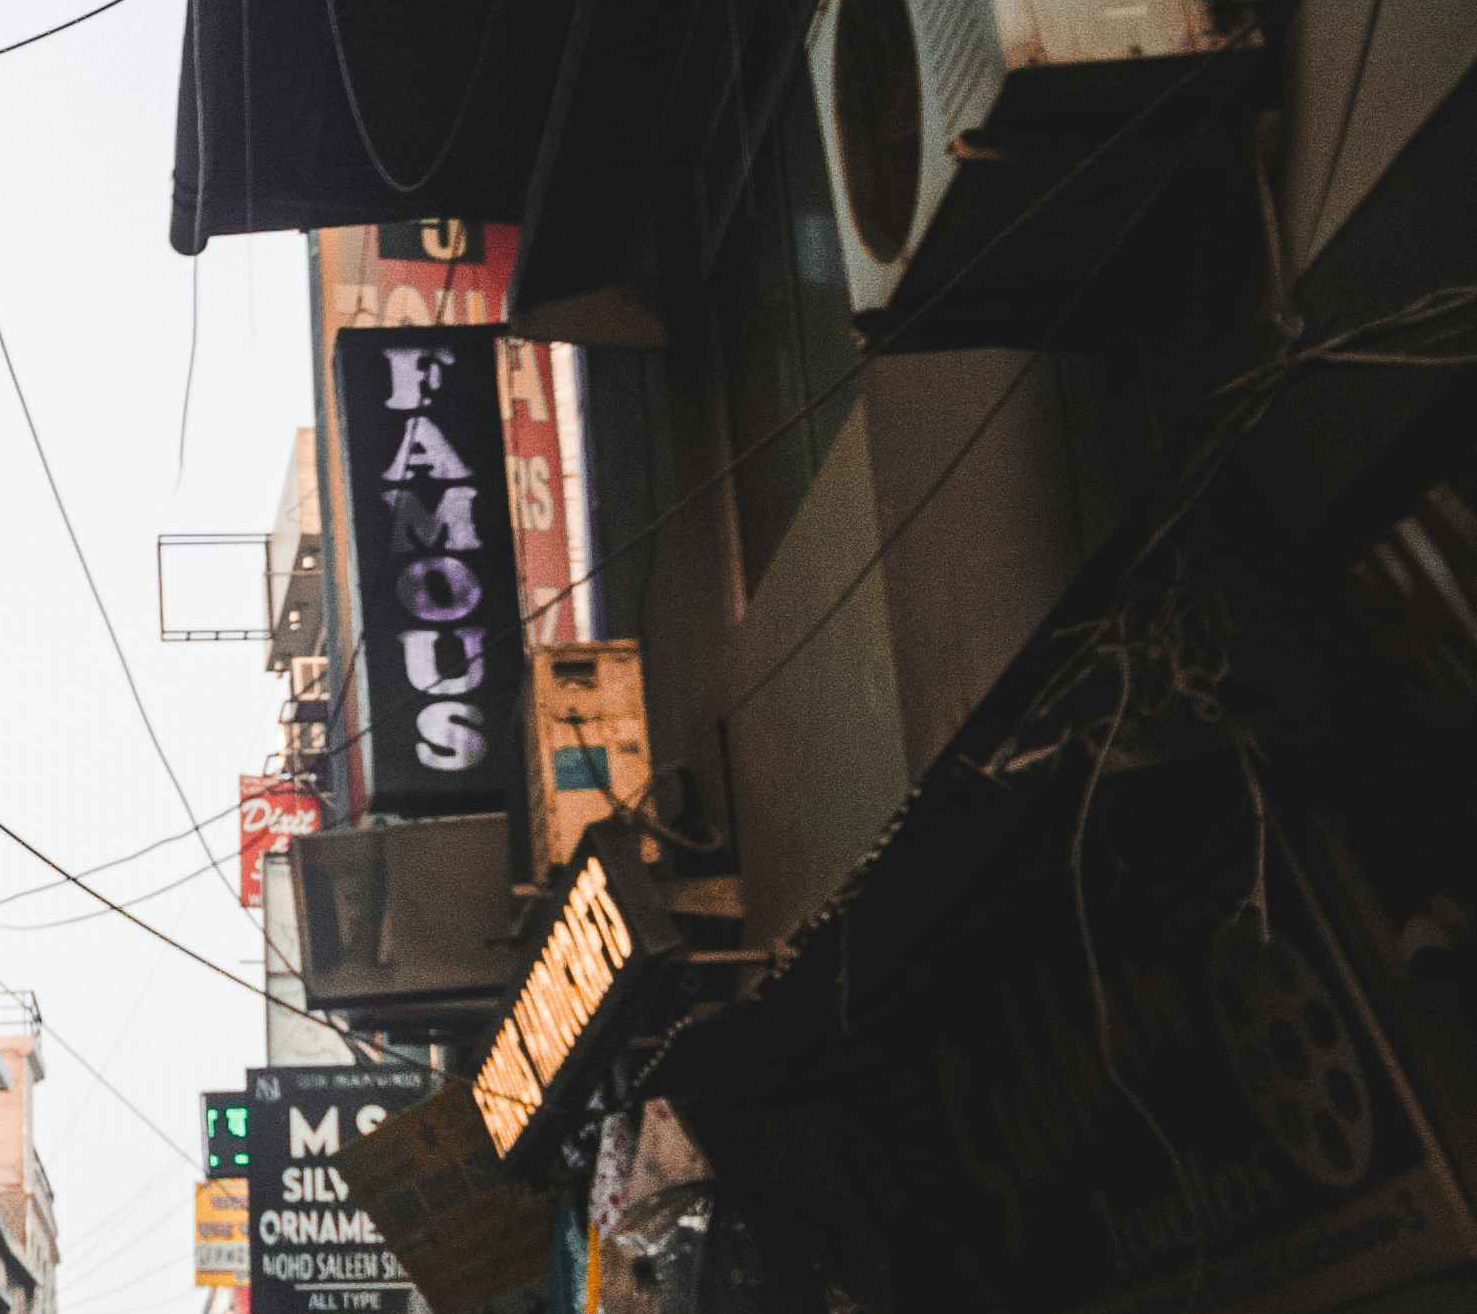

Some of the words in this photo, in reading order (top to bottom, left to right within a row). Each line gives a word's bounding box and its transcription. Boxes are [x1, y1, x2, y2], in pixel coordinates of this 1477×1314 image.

[381, 346, 488, 771] FAMOUS
[288, 1104, 341, 1160] M
[307, 1292, 339, 1311] ALL
[342, 1291, 382, 1311] TYPE
